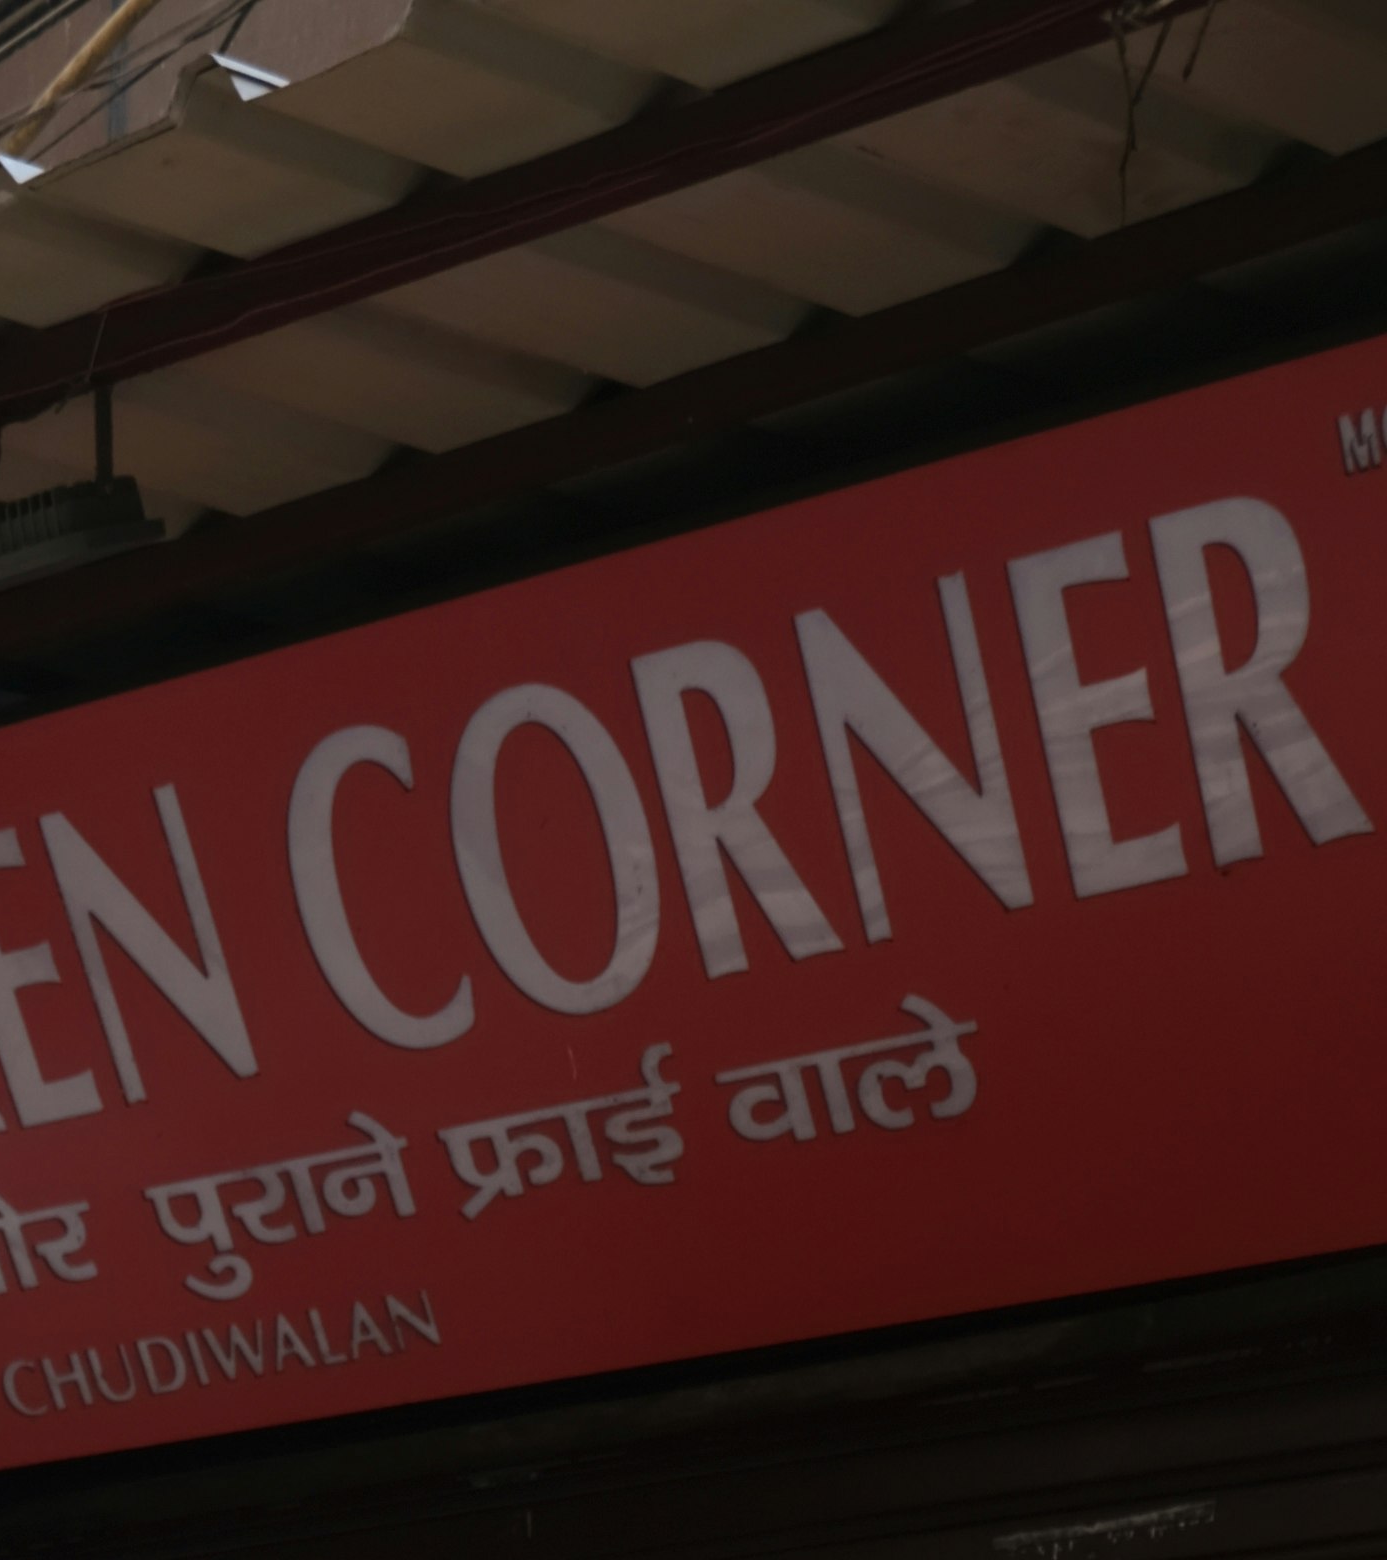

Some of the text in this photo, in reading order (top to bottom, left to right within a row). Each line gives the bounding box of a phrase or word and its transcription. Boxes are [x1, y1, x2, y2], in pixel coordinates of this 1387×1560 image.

[287, 495, 1375, 1052] CORNER
[143, 1110, 419, 1302] पुराने
[437, 1042, 689, 1222] फ्राई
[713, 994, 981, 1148] वाले
[1, 1288, 445, 1420] CHUDIWALAN
